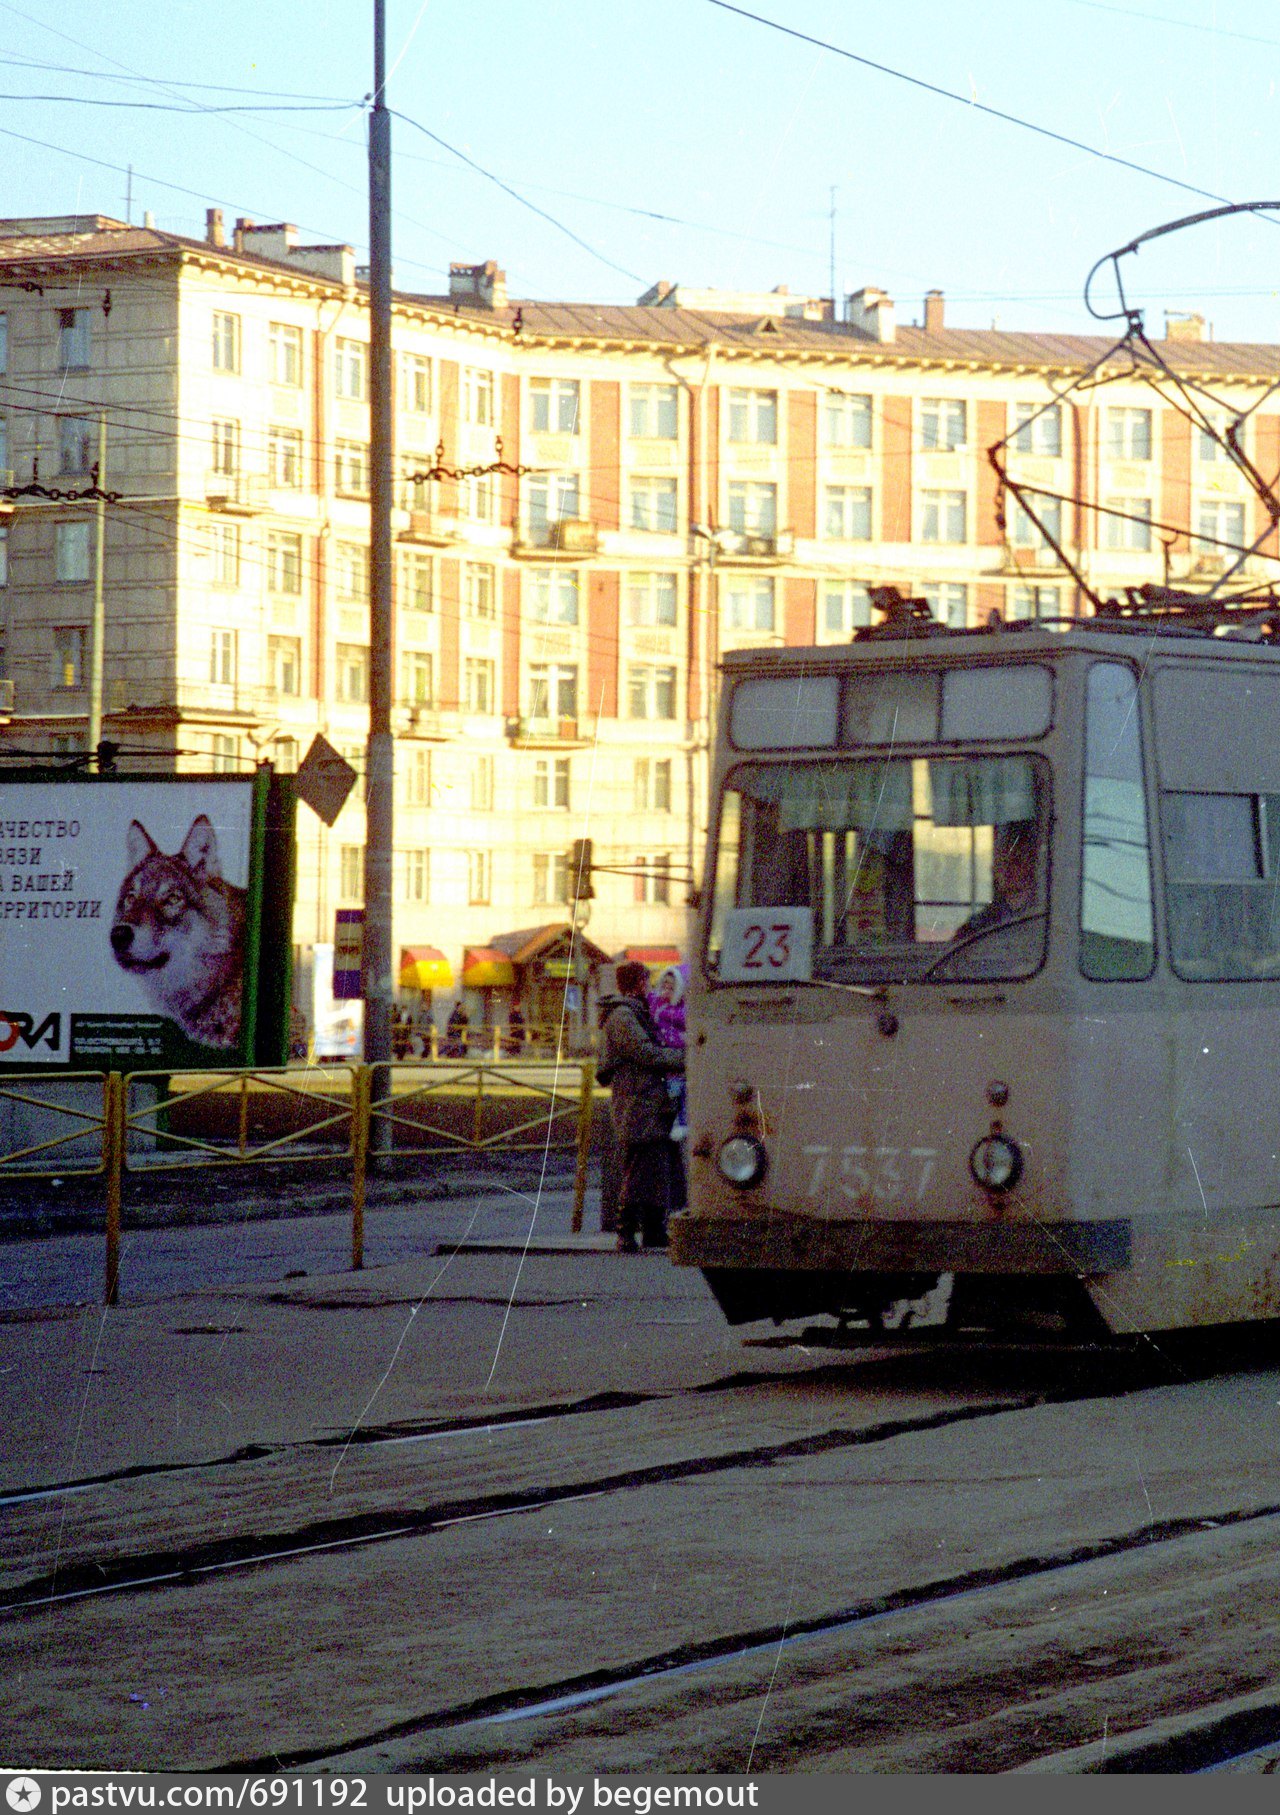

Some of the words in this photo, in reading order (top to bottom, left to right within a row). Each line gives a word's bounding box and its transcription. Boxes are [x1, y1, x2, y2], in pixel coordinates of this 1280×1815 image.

[0, 847, 42, 865] ЯЗИ
[11, 869, 74, 892] ВАШЕЙ
[0, 900, 102, 919] РРИТОРИИ
[741, 924, 792, 968] 23
[801, 1145, 941, 1200] 7537
